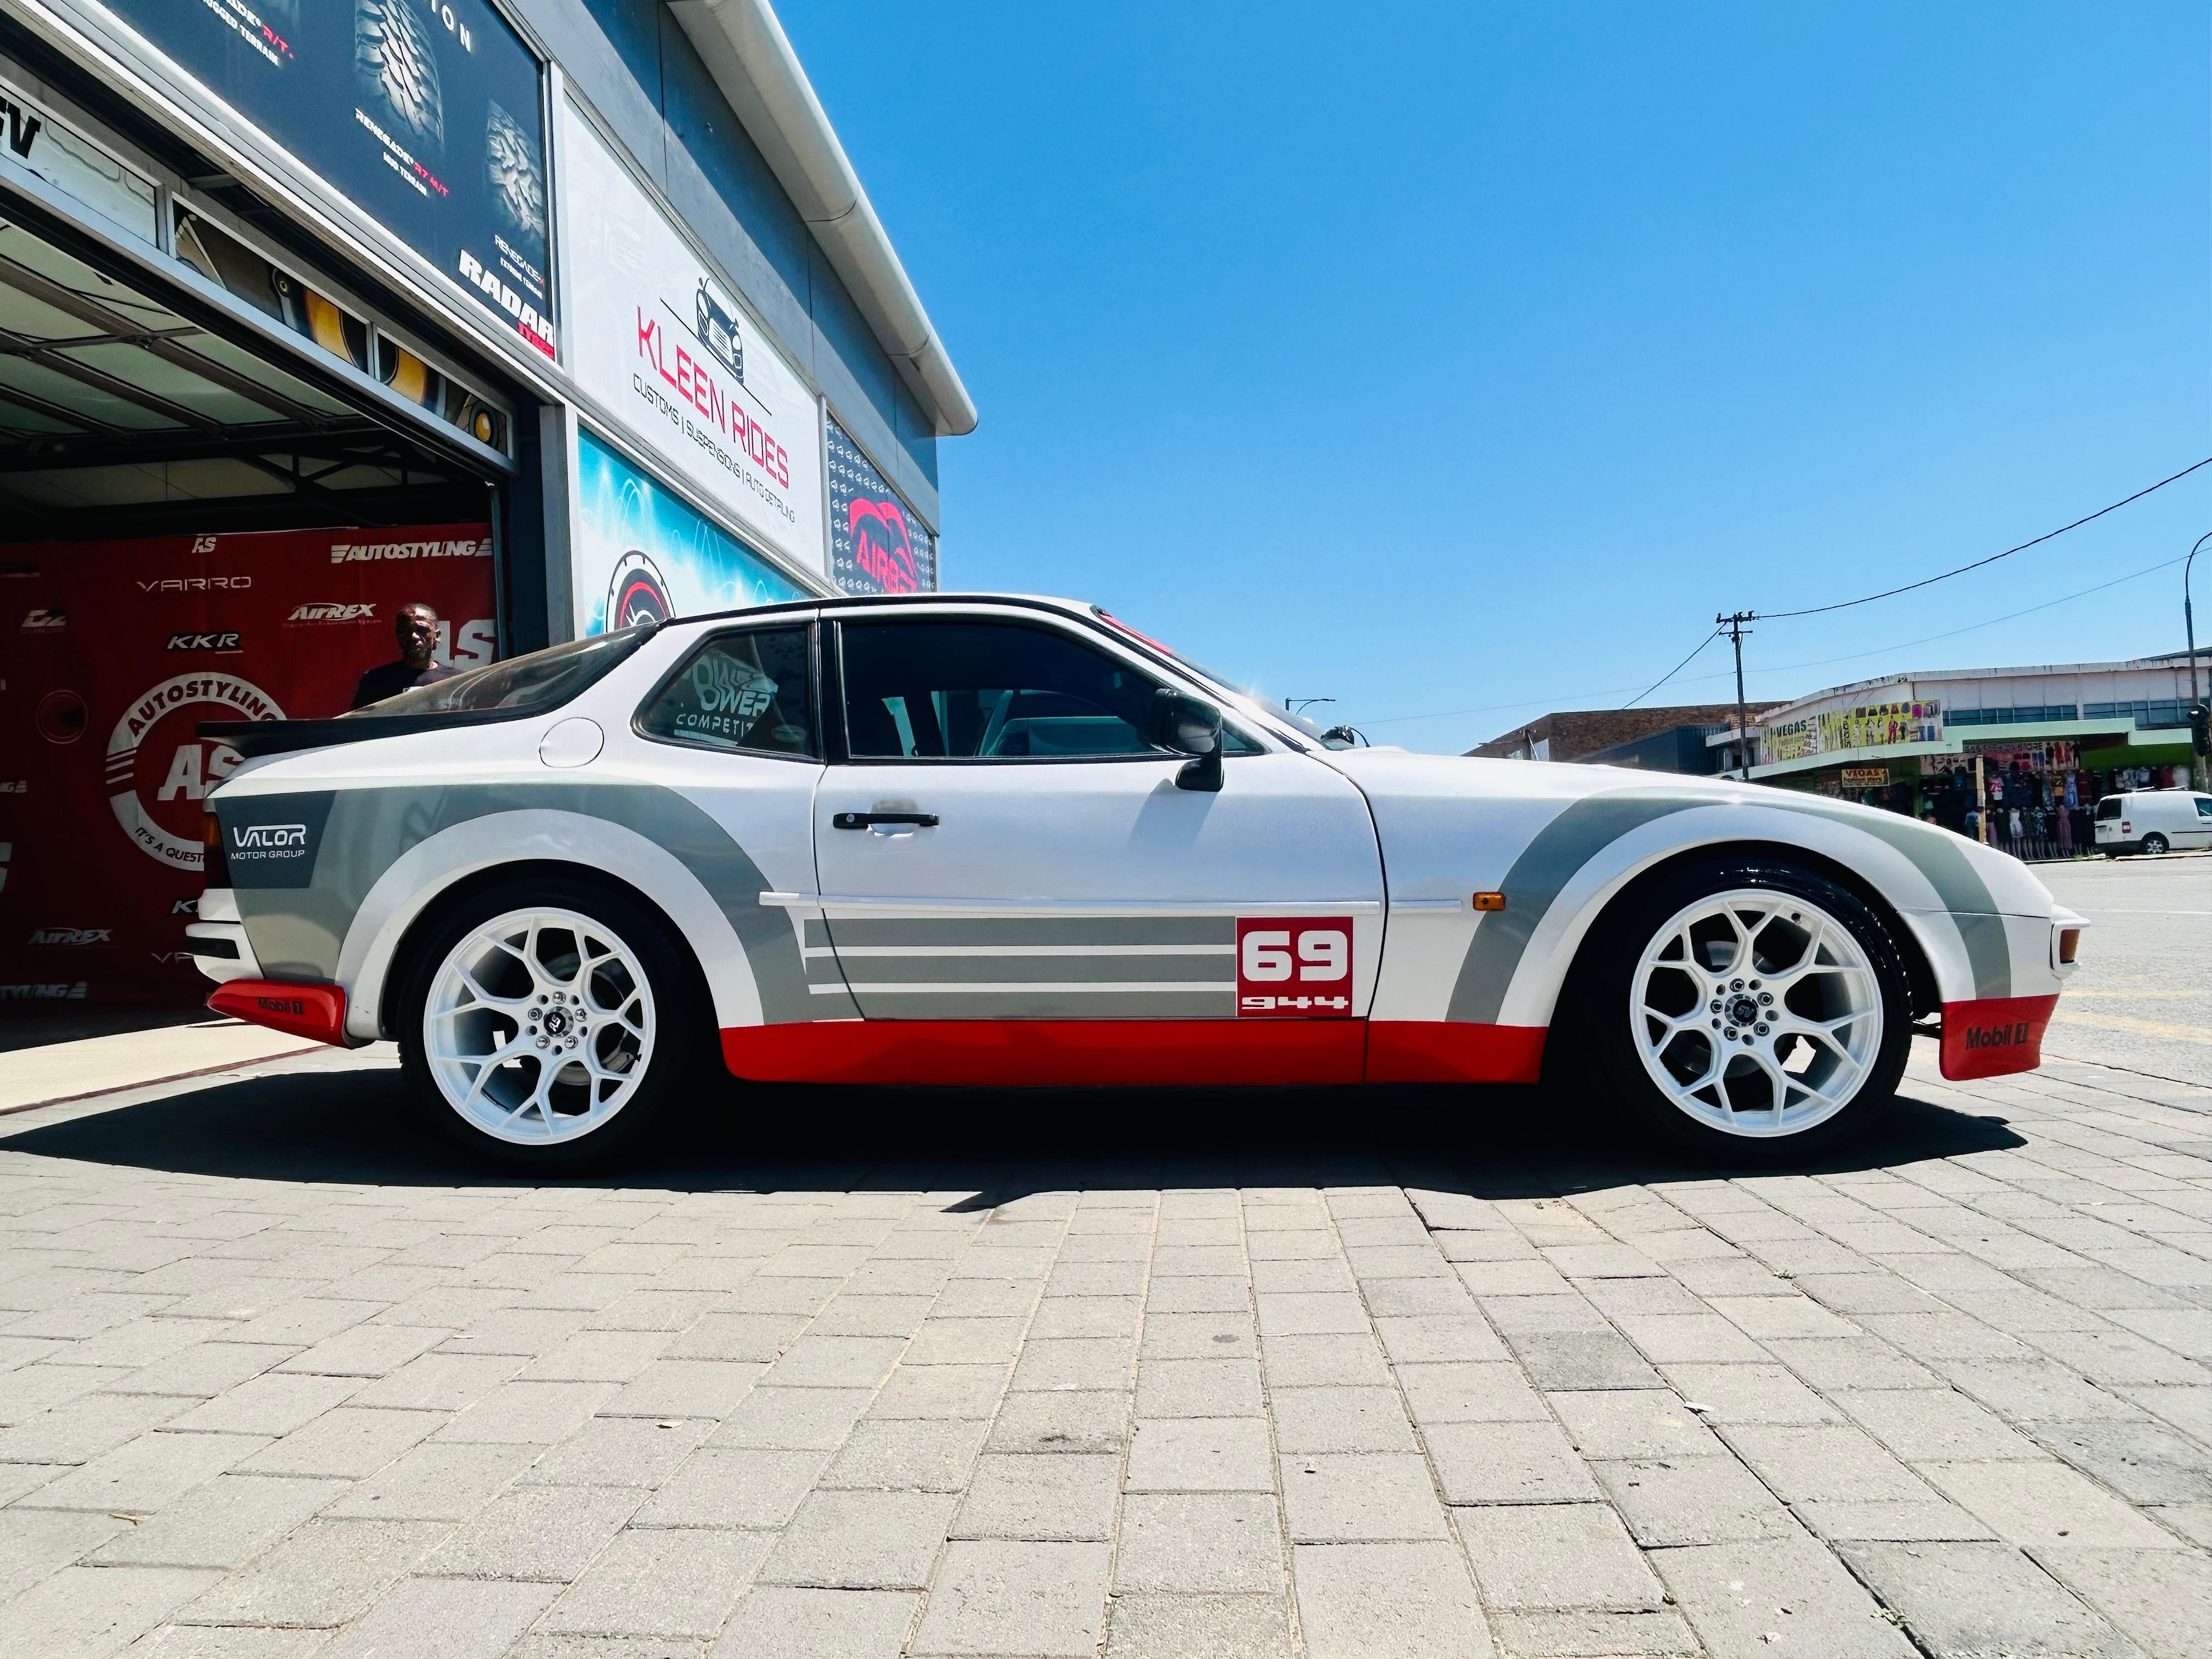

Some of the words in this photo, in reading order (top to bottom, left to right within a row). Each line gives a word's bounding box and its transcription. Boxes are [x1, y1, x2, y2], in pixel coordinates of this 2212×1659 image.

[495, 234, 541, 283] RENEGADE
[459, 249, 554, 347] RADAR
[633, 373, 679, 426] CUSTOMS
[637, 304, 725, 433] KLEEN
[732, 400, 788, 489] RIDES
[345, 540, 476, 561] AUTOSTYLING
[137, 577, 252, 592] VARRO
[167, 634, 239, 649] KKR
[1776, 719, 1807, 737] VEGAS
[136, 827, 155, 845] IT'S
[154, 843, 163, 852] A
[166, 848, 204, 863] QUEST
[233, 824, 306, 847] VALOR
[231, 851, 266, 860] MOTOR
[269, 850, 305, 858] GROUP
[1243, 930, 1348, 981] 69
[257, 997, 290, 1013] Mobil
[1242, 996, 1348, 1009] 944
[1966, 1023, 2013, 1049] Mobil
